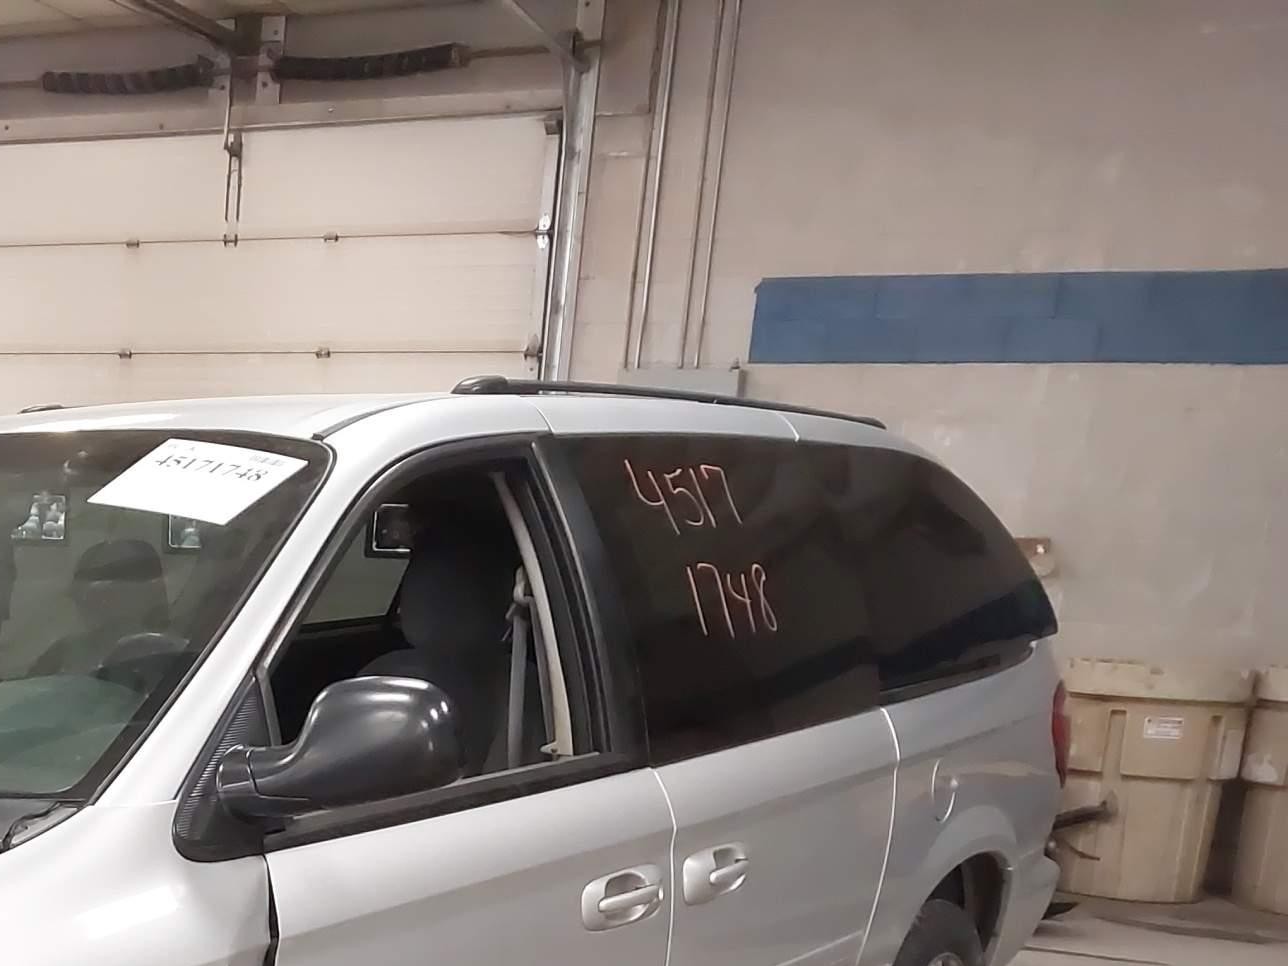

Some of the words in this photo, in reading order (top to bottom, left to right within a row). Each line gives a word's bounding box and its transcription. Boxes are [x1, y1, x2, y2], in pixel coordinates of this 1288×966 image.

[155, 454, 269, 482] 45171748
[624, 459, 743, 535] 4517
[684, 563, 778, 639] 1748
